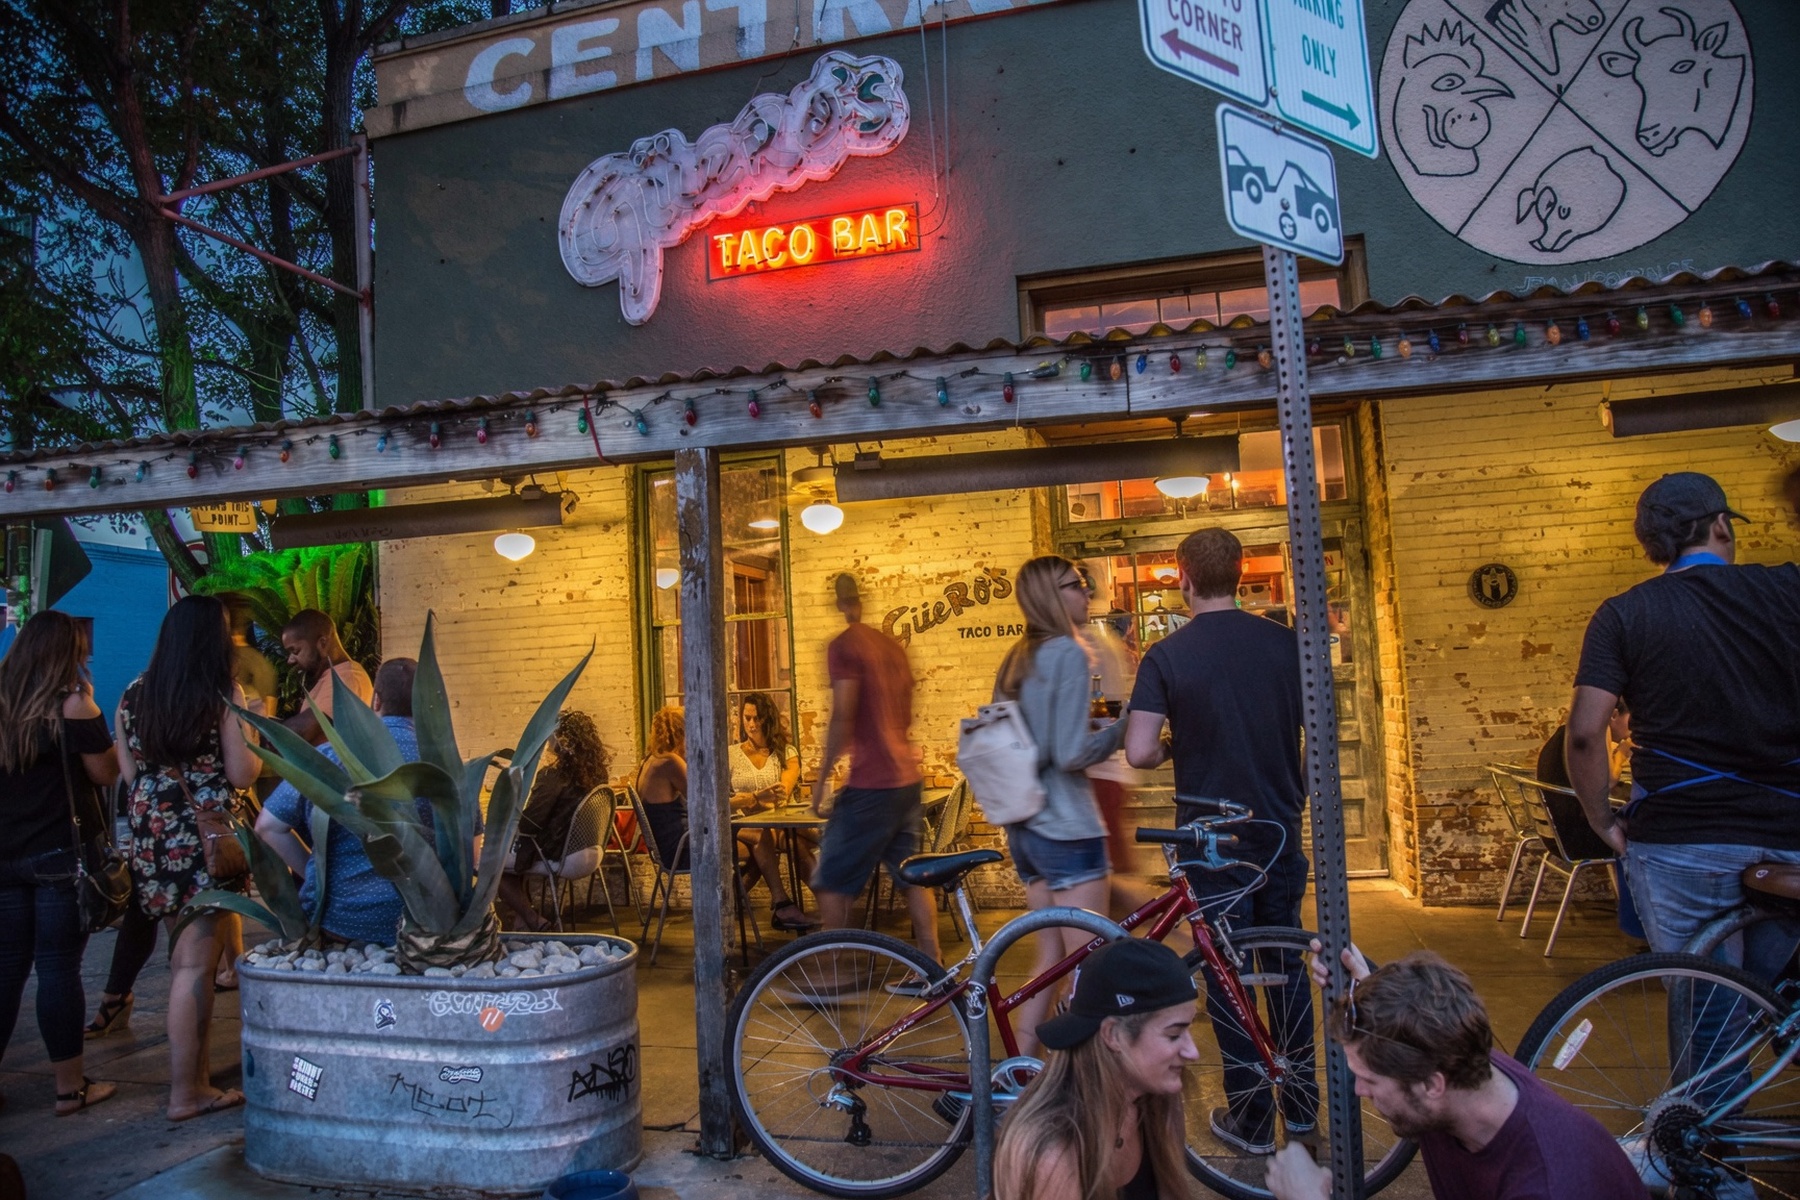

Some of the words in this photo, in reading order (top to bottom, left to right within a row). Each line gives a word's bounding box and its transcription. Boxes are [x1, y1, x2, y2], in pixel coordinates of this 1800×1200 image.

[1168, 0, 1243, 52] CORNER
[1302, 34, 1336, 78] ONLY
[714, 225, 815, 272] TACO
[832, 209, 910, 256] BAR
[212, 514, 239, 526] POINT
[957, 626, 992, 639] TACO
[997, 624, 1024, 637] BAR
